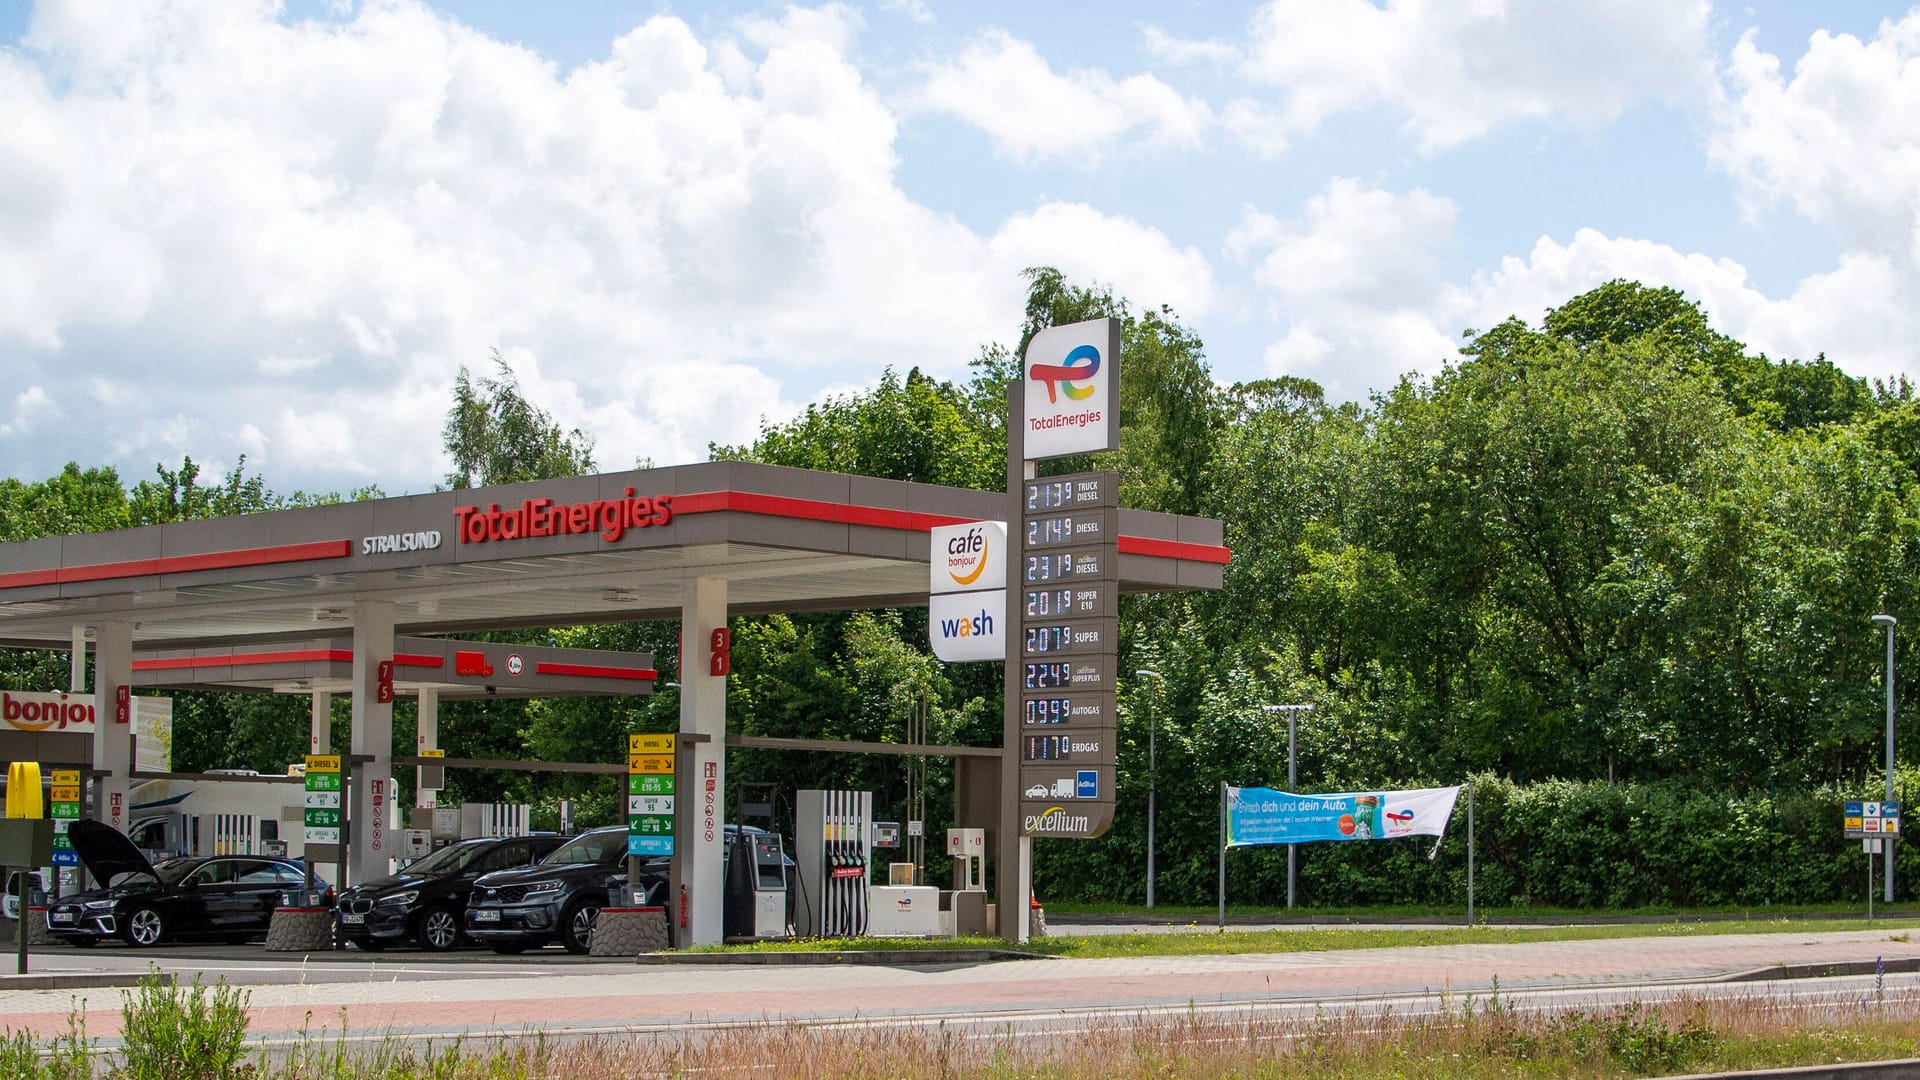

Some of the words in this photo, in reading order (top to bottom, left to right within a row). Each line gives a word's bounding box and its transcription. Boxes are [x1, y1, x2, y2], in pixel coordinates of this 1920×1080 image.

[1030, 410, 1101, 431] TotalEnergies
[1078, 481, 1098, 491] TRUCK
[1077, 491, 1098, 501] DIESEL
[453, 486, 673, 544] TotalEnergies
[1028, 518, 1072, 545] 2149
[1076, 522, 1099, 533] DIESEL
[362, 531, 442, 555] STRALSUND
[948, 528, 983, 555] café
[948, 556, 976, 568] bonjour
[1028, 554, 1072, 580] 2319
[1076, 563, 1098, 574] DIESEL
[1077, 591, 1097, 600] SUPER
[1028, 590, 1071, 616] 2019
[1081, 601, 1093, 610] E10
[942, 608, 993, 638] wash
[716, 633, 724, 647] 3
[1075, 632, 1098, 643] SUPER
[717, 656, 722, 671] 1
[382, 664, 388, 678] 7
[1027, 663, 1070, 688] 2249
[119, 689, 126, 701] 11
[382, 686, 388, 699] 5
[120, 708, 125, 720] 9
[1026, 700, 1069, 724] 0999
[1072, 706, 1100, 715] AUTOGAS
[1031, 736, 1069, 759] 1170
[1072, 743, 1099, 752] ERDGAS
[314, 760, 331, 768] DIESEL
[1261, 800, 1278, 813] dich
[1279, 801, 1296, 812] und
[1298, 800, 1319, 812] dein
[1321, 799, 1348, 811] Auto.
[1024, 810, 1088, 833] excellium
